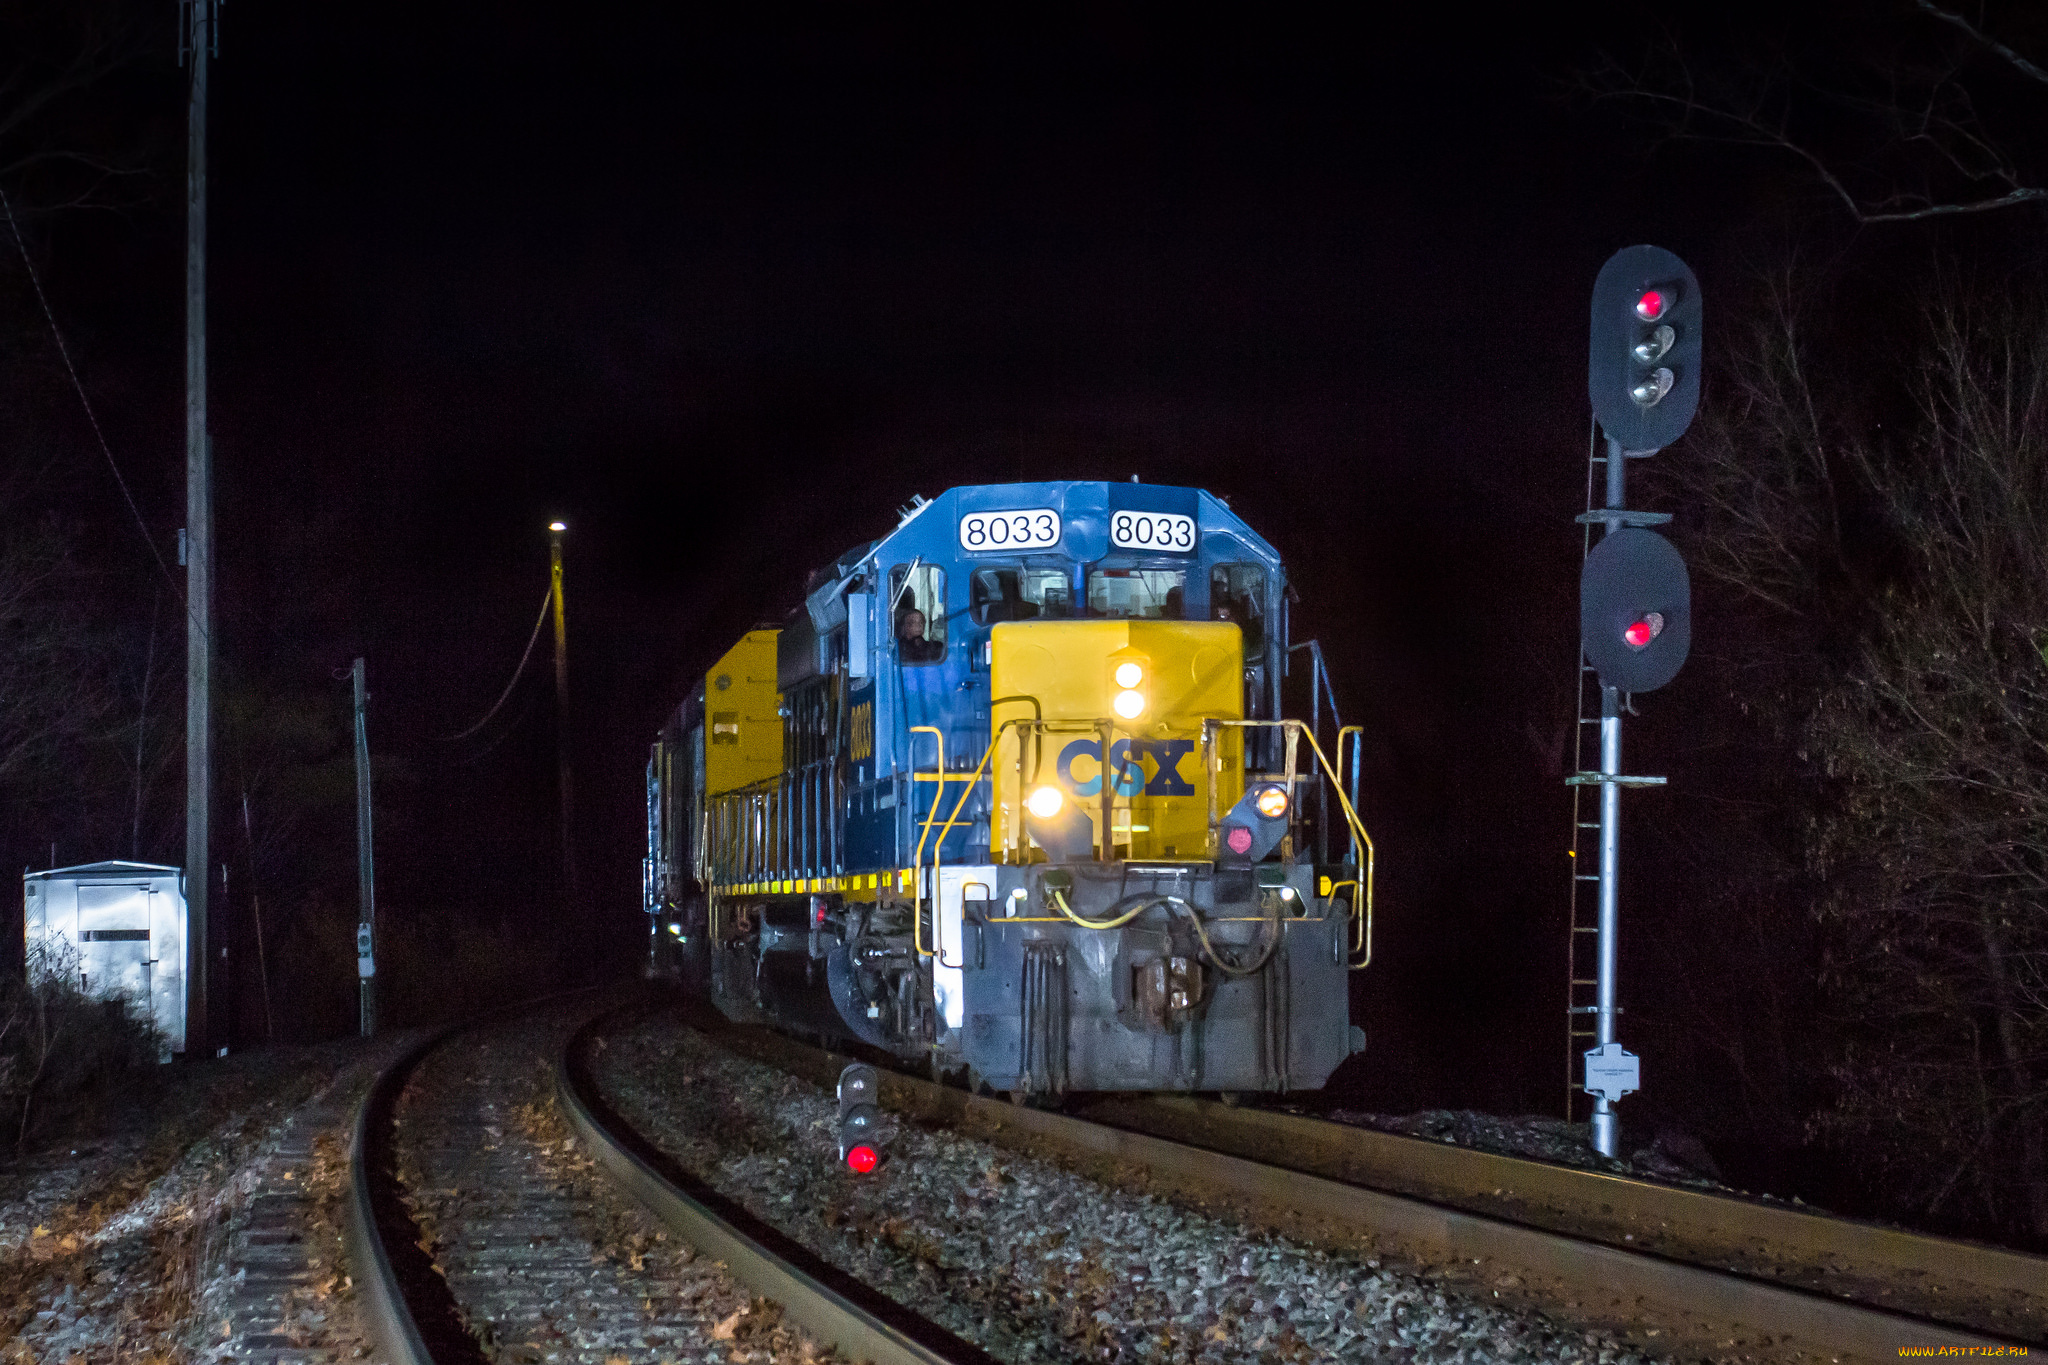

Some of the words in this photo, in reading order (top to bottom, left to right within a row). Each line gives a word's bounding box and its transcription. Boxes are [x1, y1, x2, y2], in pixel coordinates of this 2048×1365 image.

[967, 515, 1055, 546] 8033
[1115, 515, 1192, 547] 8033
[1057, 738, 1195, 797] CSX
